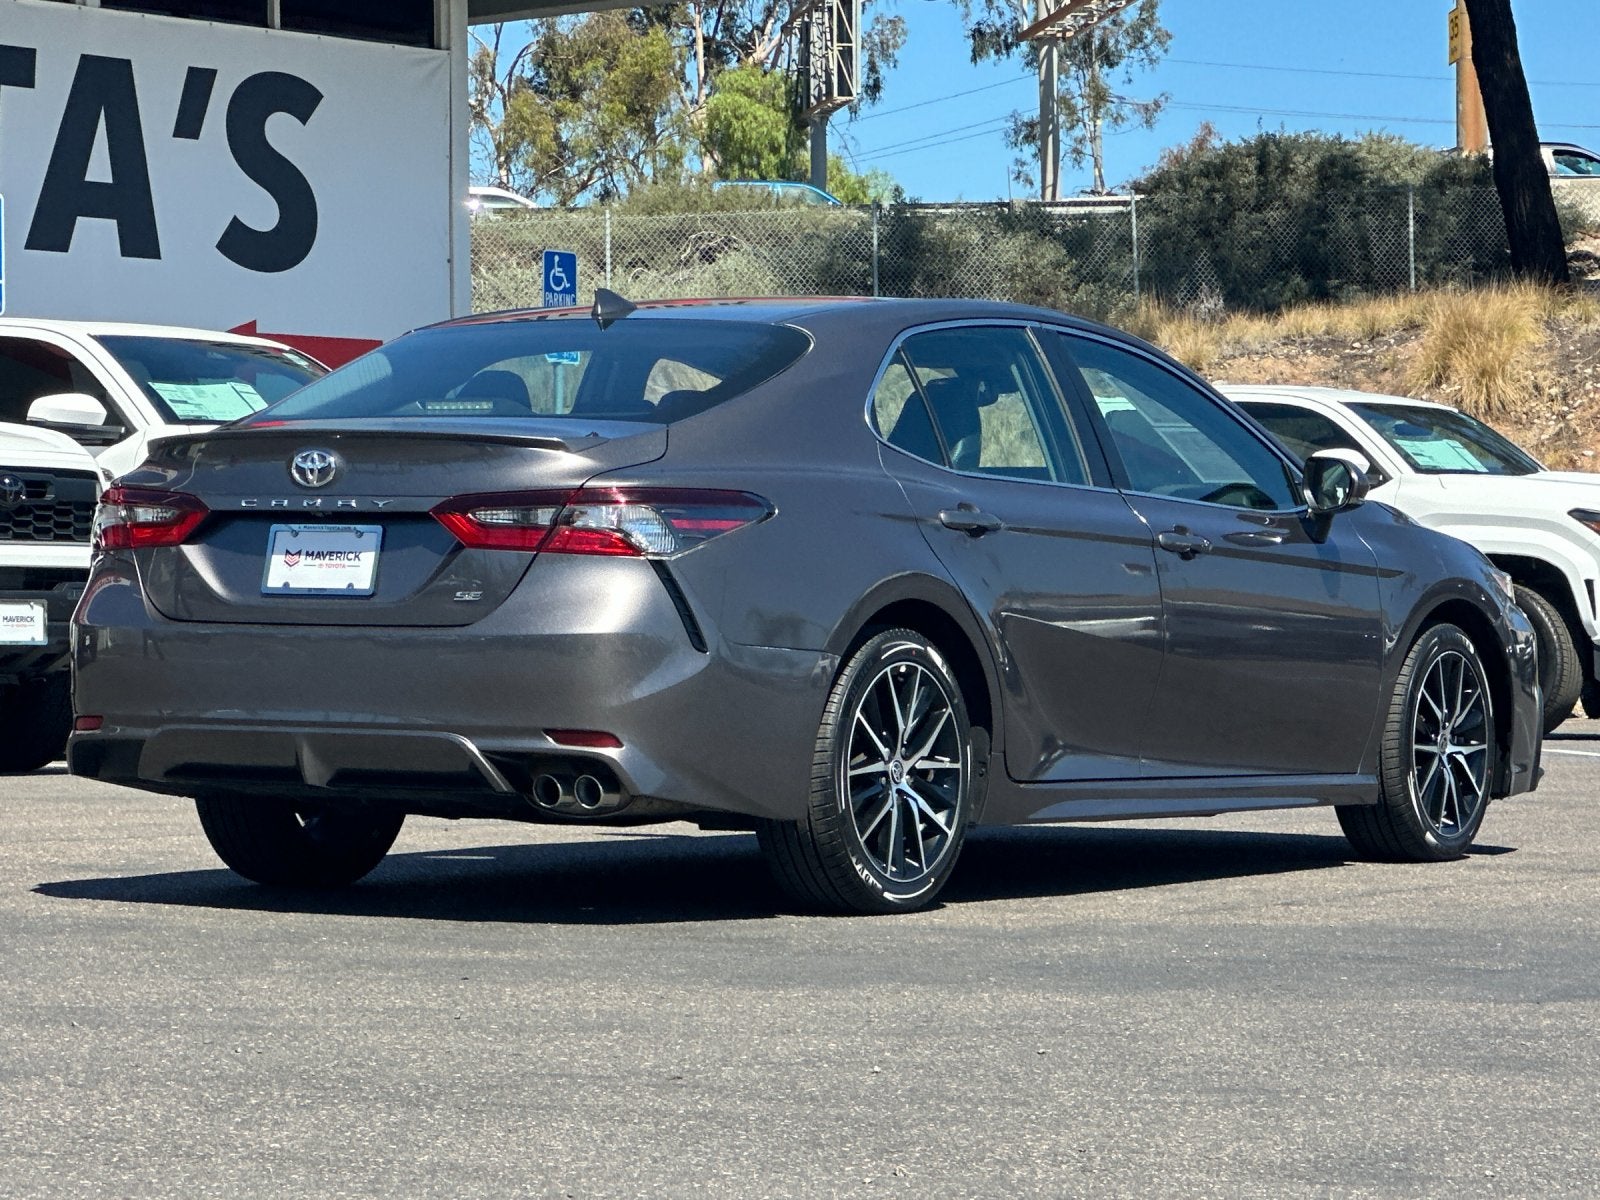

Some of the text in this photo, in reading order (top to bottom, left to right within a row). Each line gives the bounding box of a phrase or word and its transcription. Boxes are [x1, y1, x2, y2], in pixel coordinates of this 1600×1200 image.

[545, 291, 576, 307] PARKING
[240, 498, 394, 508] CAMRY
[304, 550, 362, 561] MAVERICK
[453, 591, 483, 601] SE
[2, 615, 35, 623] MAVERICK
